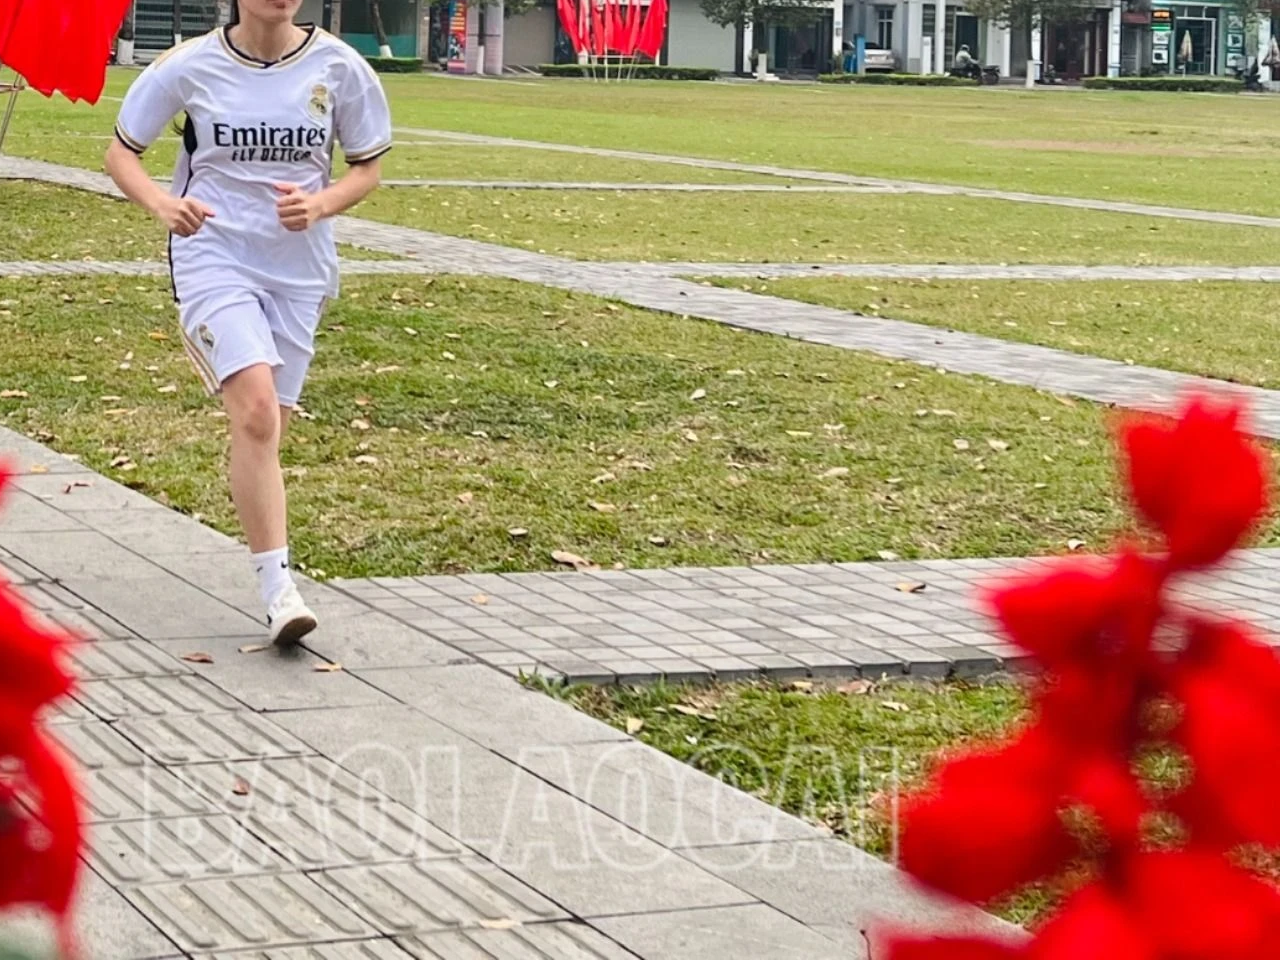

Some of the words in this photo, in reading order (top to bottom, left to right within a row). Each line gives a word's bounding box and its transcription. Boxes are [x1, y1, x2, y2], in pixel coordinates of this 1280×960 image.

[213, 121, 326, 147] Emirates
[231, 148, 256, 162] FLY
[260, 148, 312, 162] BETTER
